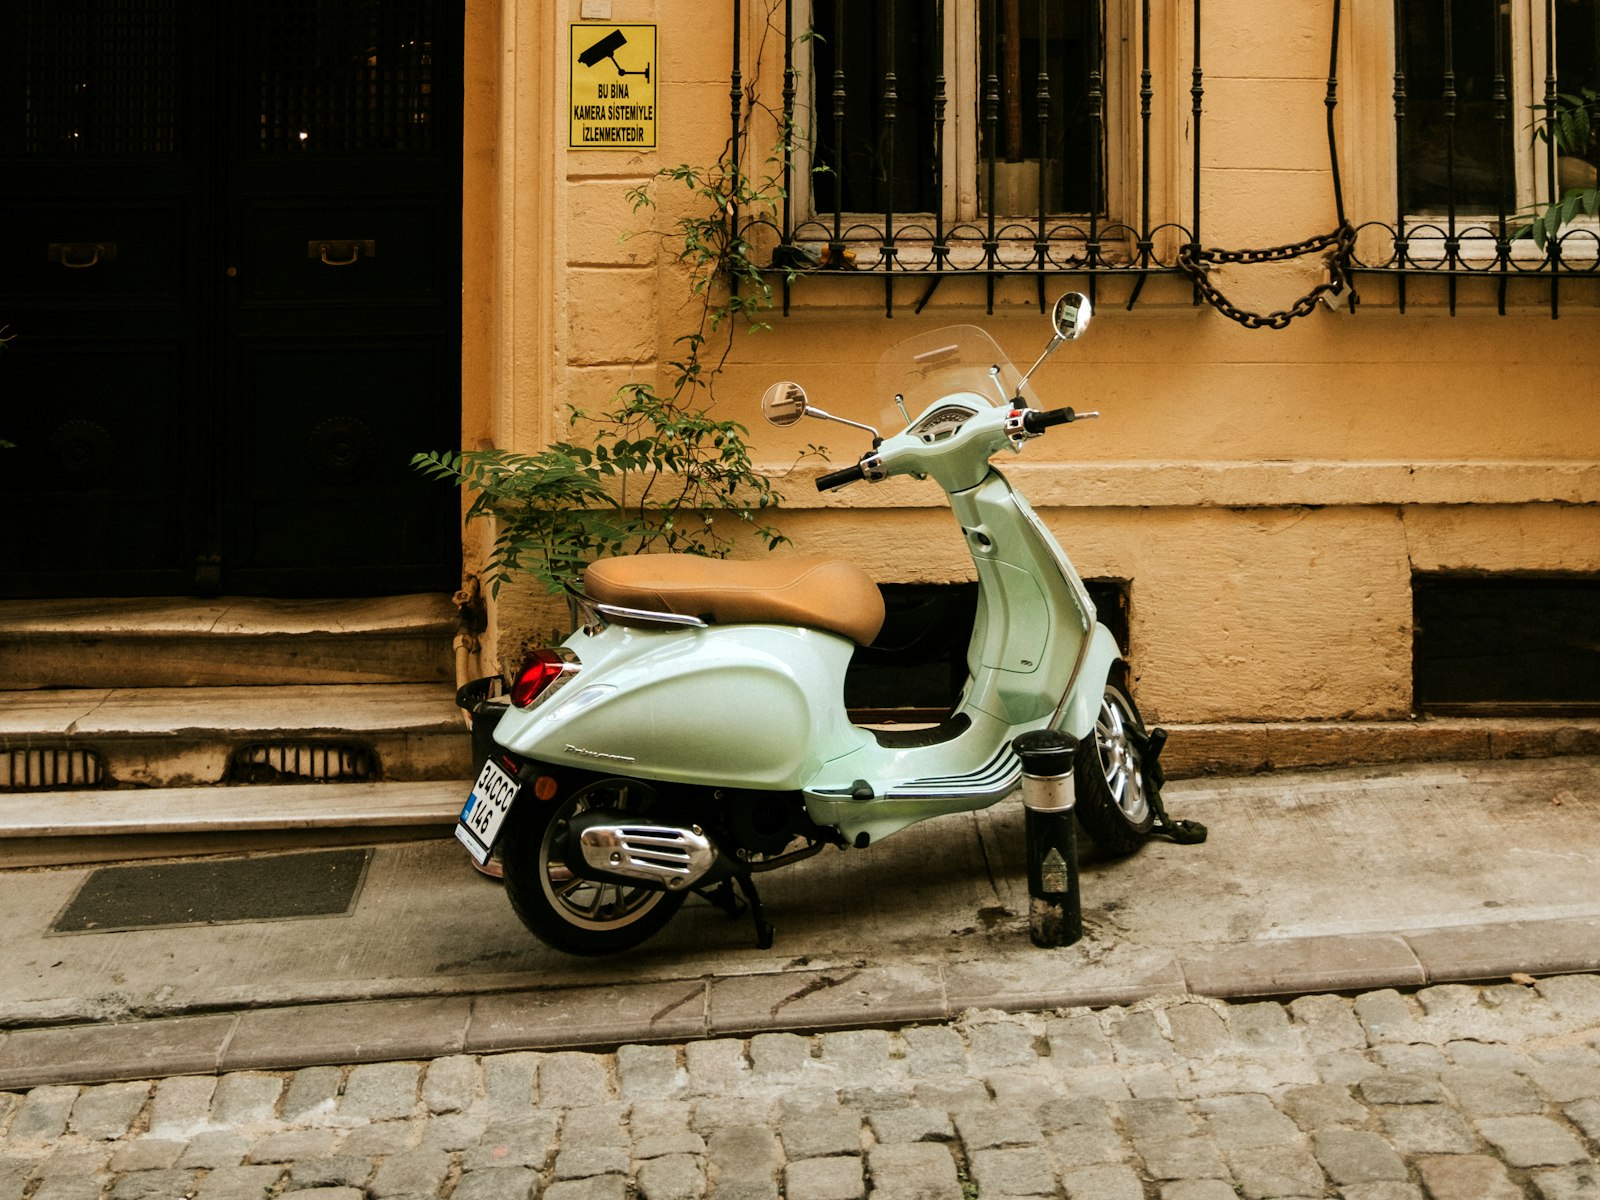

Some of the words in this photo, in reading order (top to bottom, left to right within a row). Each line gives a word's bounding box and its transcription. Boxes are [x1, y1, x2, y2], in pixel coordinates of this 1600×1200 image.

[597, 83, 609, 99] BU
[610, 80, 629, 99] BİNA
[573, 105, 606, 120] KAMERA
[608, 101, 653, 120] SİSTEMİYLE
[582, 122, 644, 142] İZLENMEKTEDİR
[478, 765, 514, 813] 34CCC
[471, 799, 493, 835] 146
